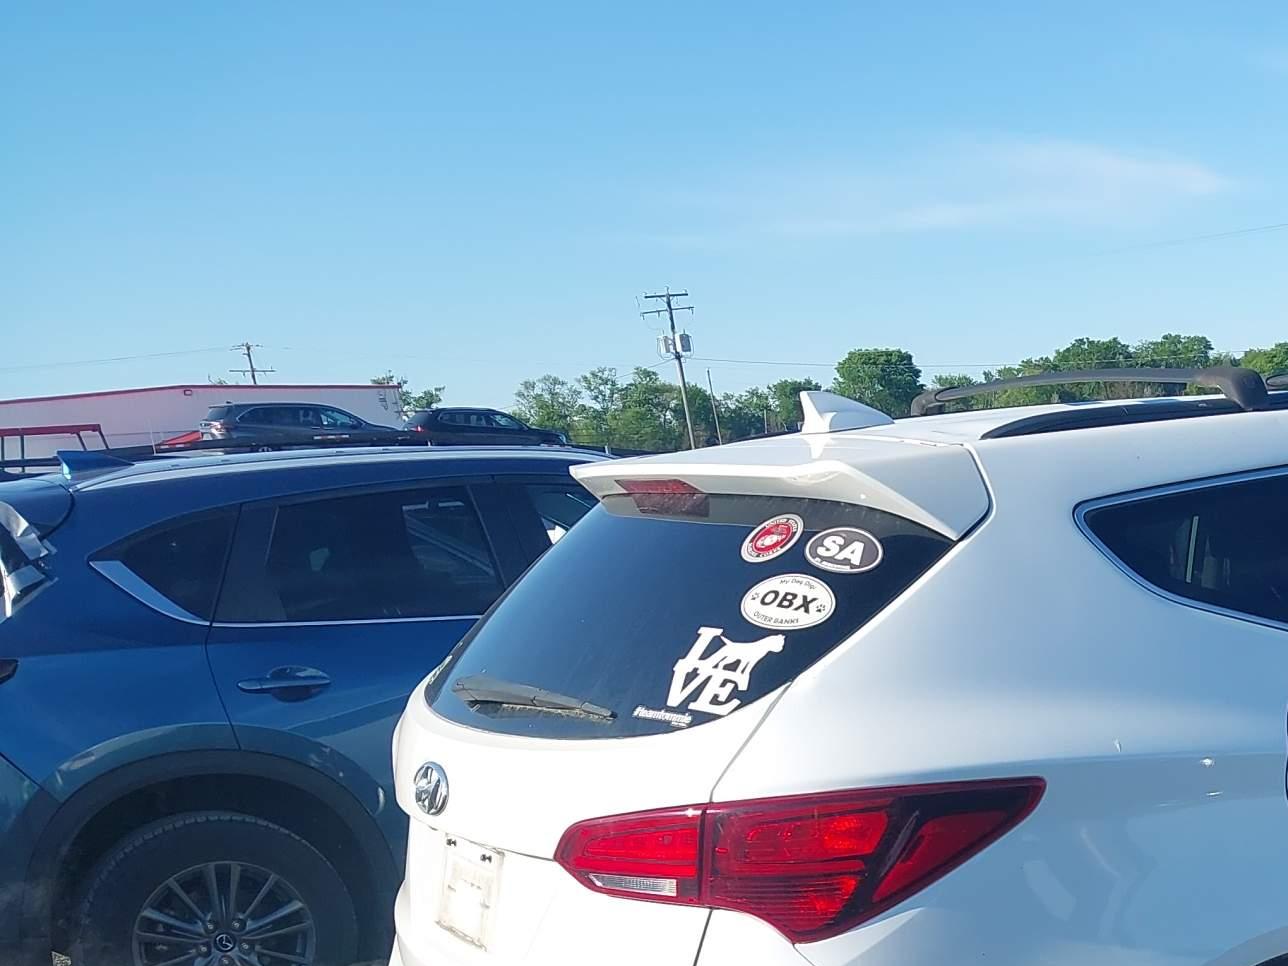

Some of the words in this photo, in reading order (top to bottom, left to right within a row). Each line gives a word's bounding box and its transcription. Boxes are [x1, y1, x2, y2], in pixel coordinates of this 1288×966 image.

[817, 535, 865, 566] SA
[760, 590, 819, 614] OBX
[753, 611, 773, 624] OUTER
[773, 617, 799, 625] BANKS
